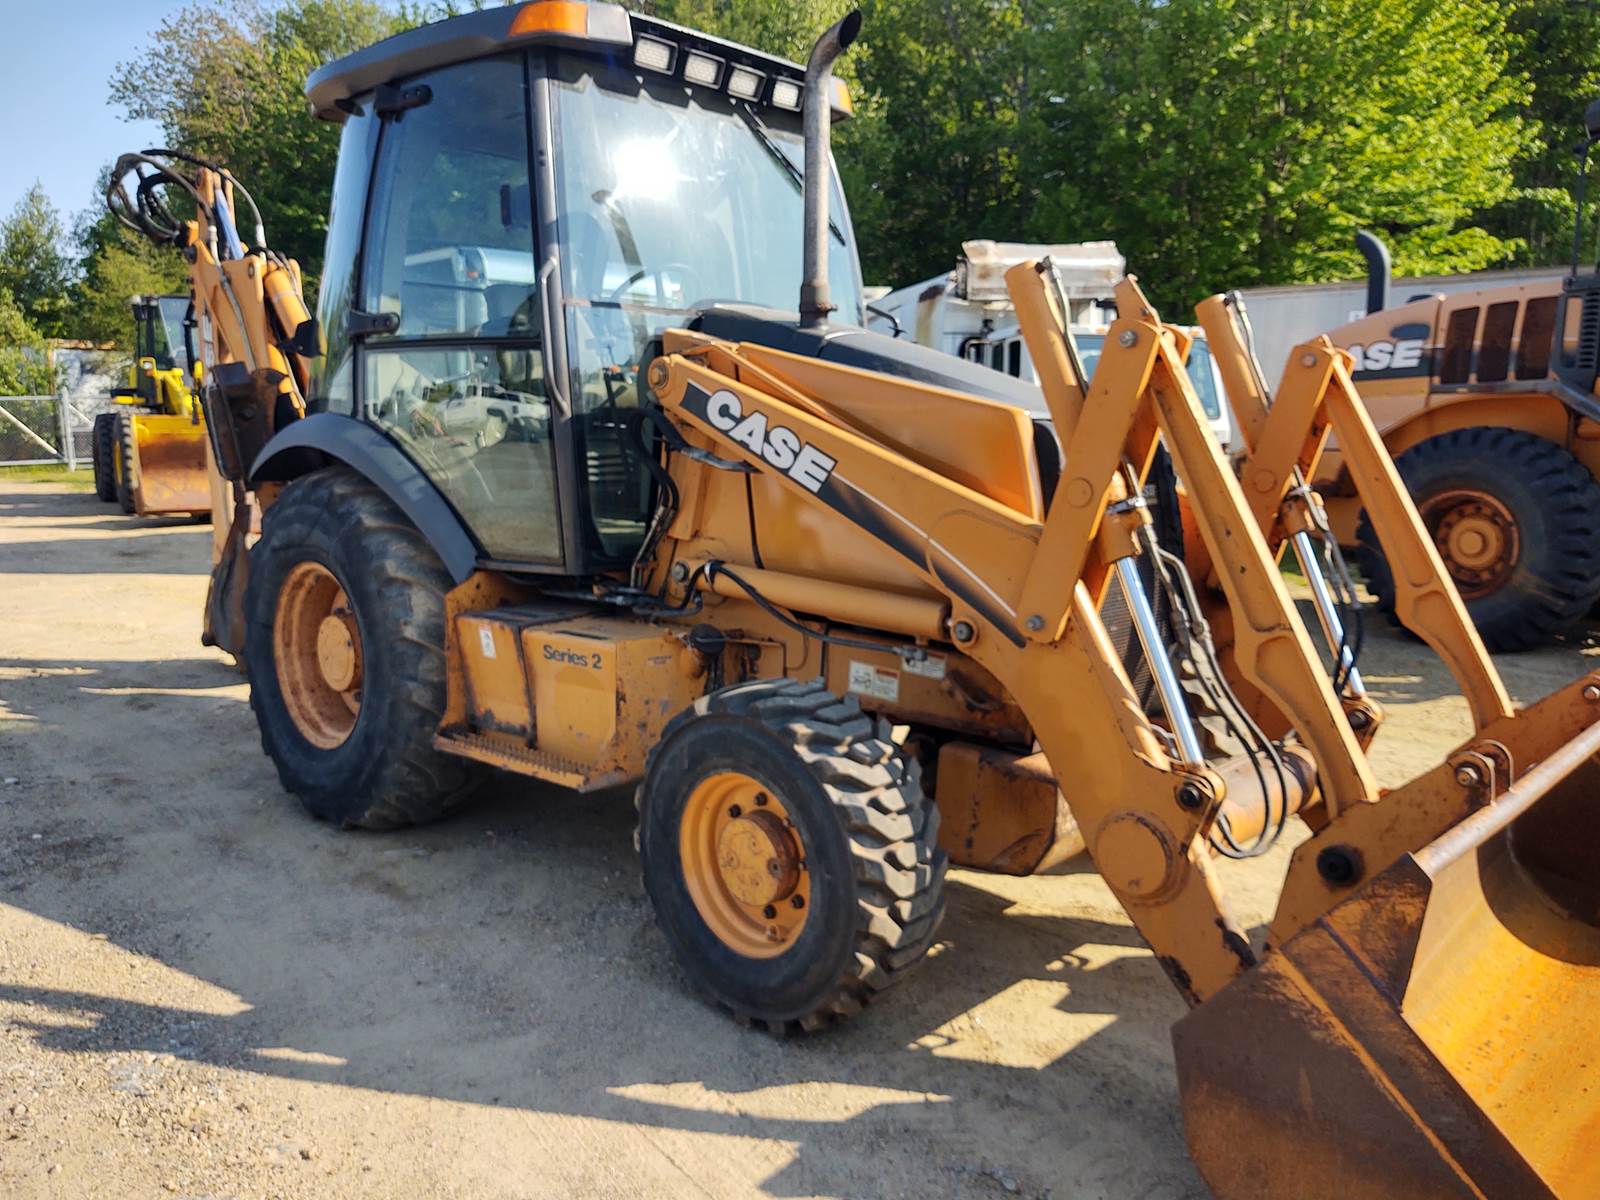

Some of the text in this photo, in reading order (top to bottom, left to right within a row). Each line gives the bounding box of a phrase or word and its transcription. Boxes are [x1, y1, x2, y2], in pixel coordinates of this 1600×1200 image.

[1347, 339, 1424, 371] ASE
[706, 389, 837, 494] CASE
[543, 644, 603, 670] Series 2
